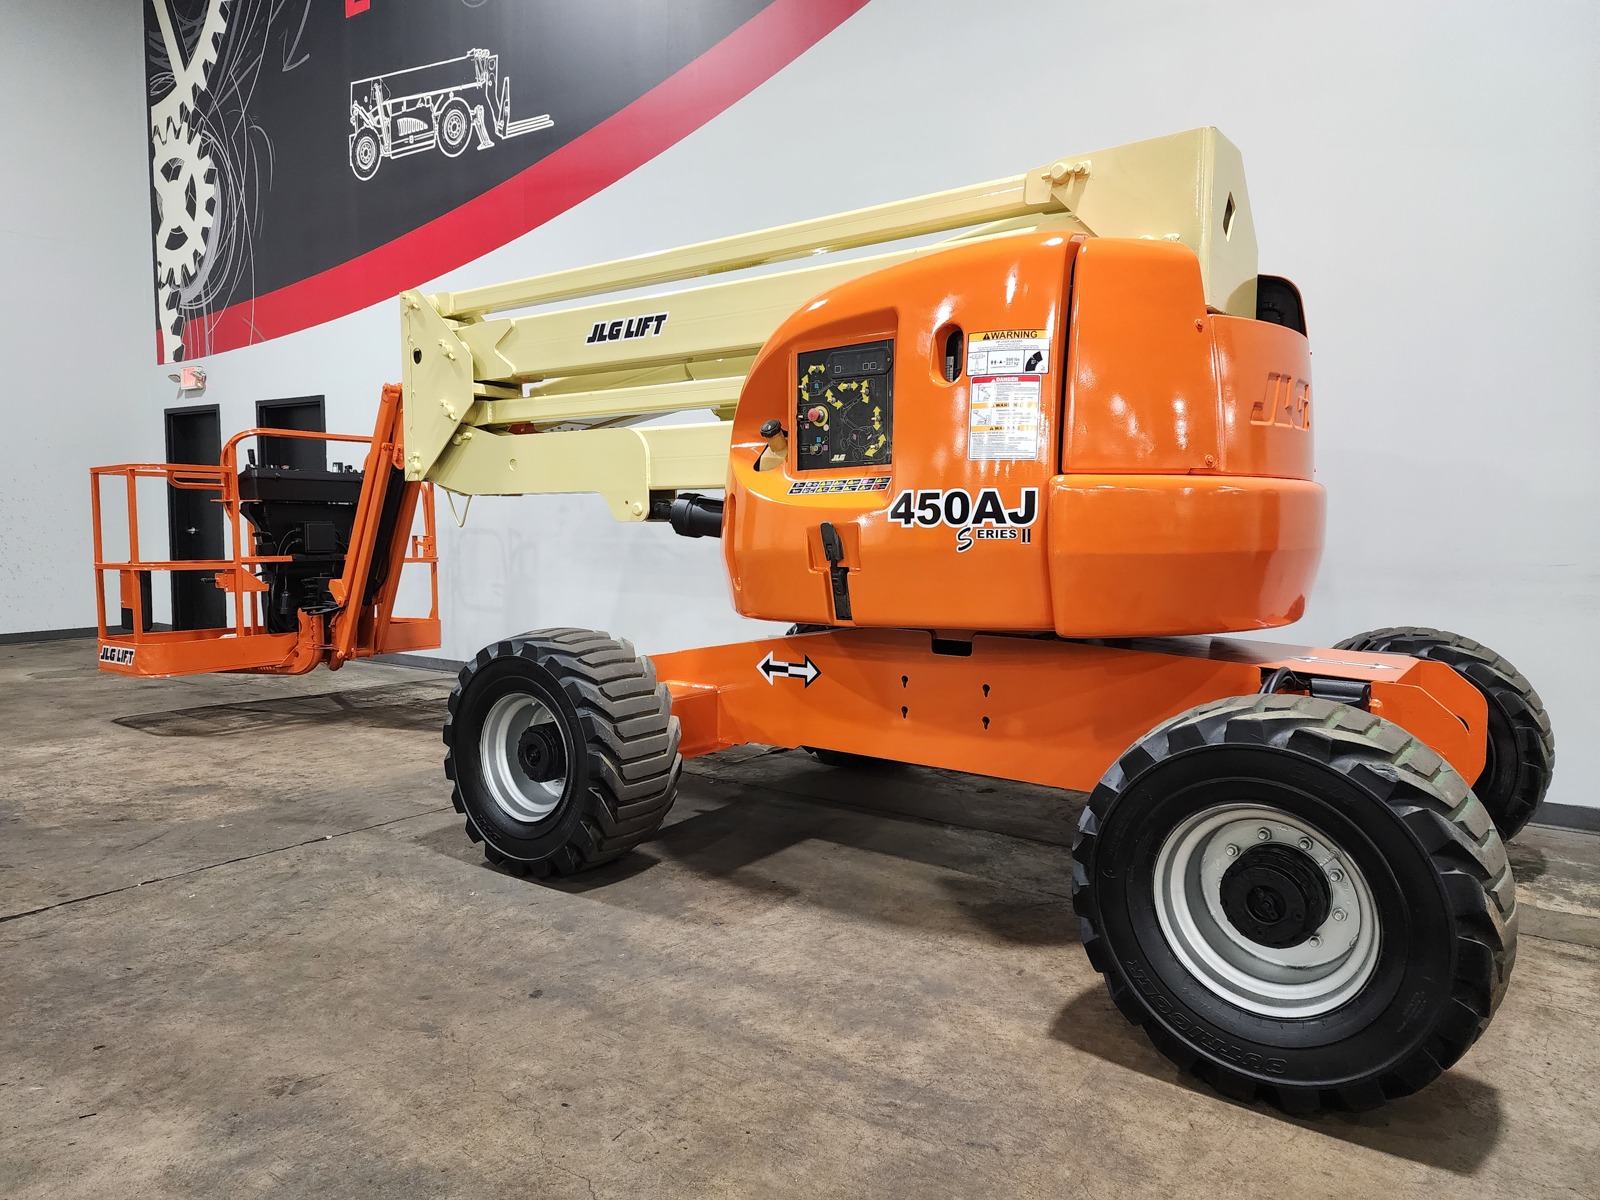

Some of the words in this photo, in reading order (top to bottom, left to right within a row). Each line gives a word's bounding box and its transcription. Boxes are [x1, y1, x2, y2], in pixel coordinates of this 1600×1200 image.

[586, 320, 624, 344] JLG
[624, 313, 668, 339] LIFT
[990, 330, 1038, 339] WARNING
[1250, 371, 1310, 432] JLG
[831, 453, 846, 462] JLG
[889, 489, 1037, 526] 450AJ
[957, 526, 1017, 551] SERIES
[100, 647, 116, 662] JLG
[117, 649, 134, 664] LIFT
[1125, 959, 1288, 1074] OUTRIGGER
